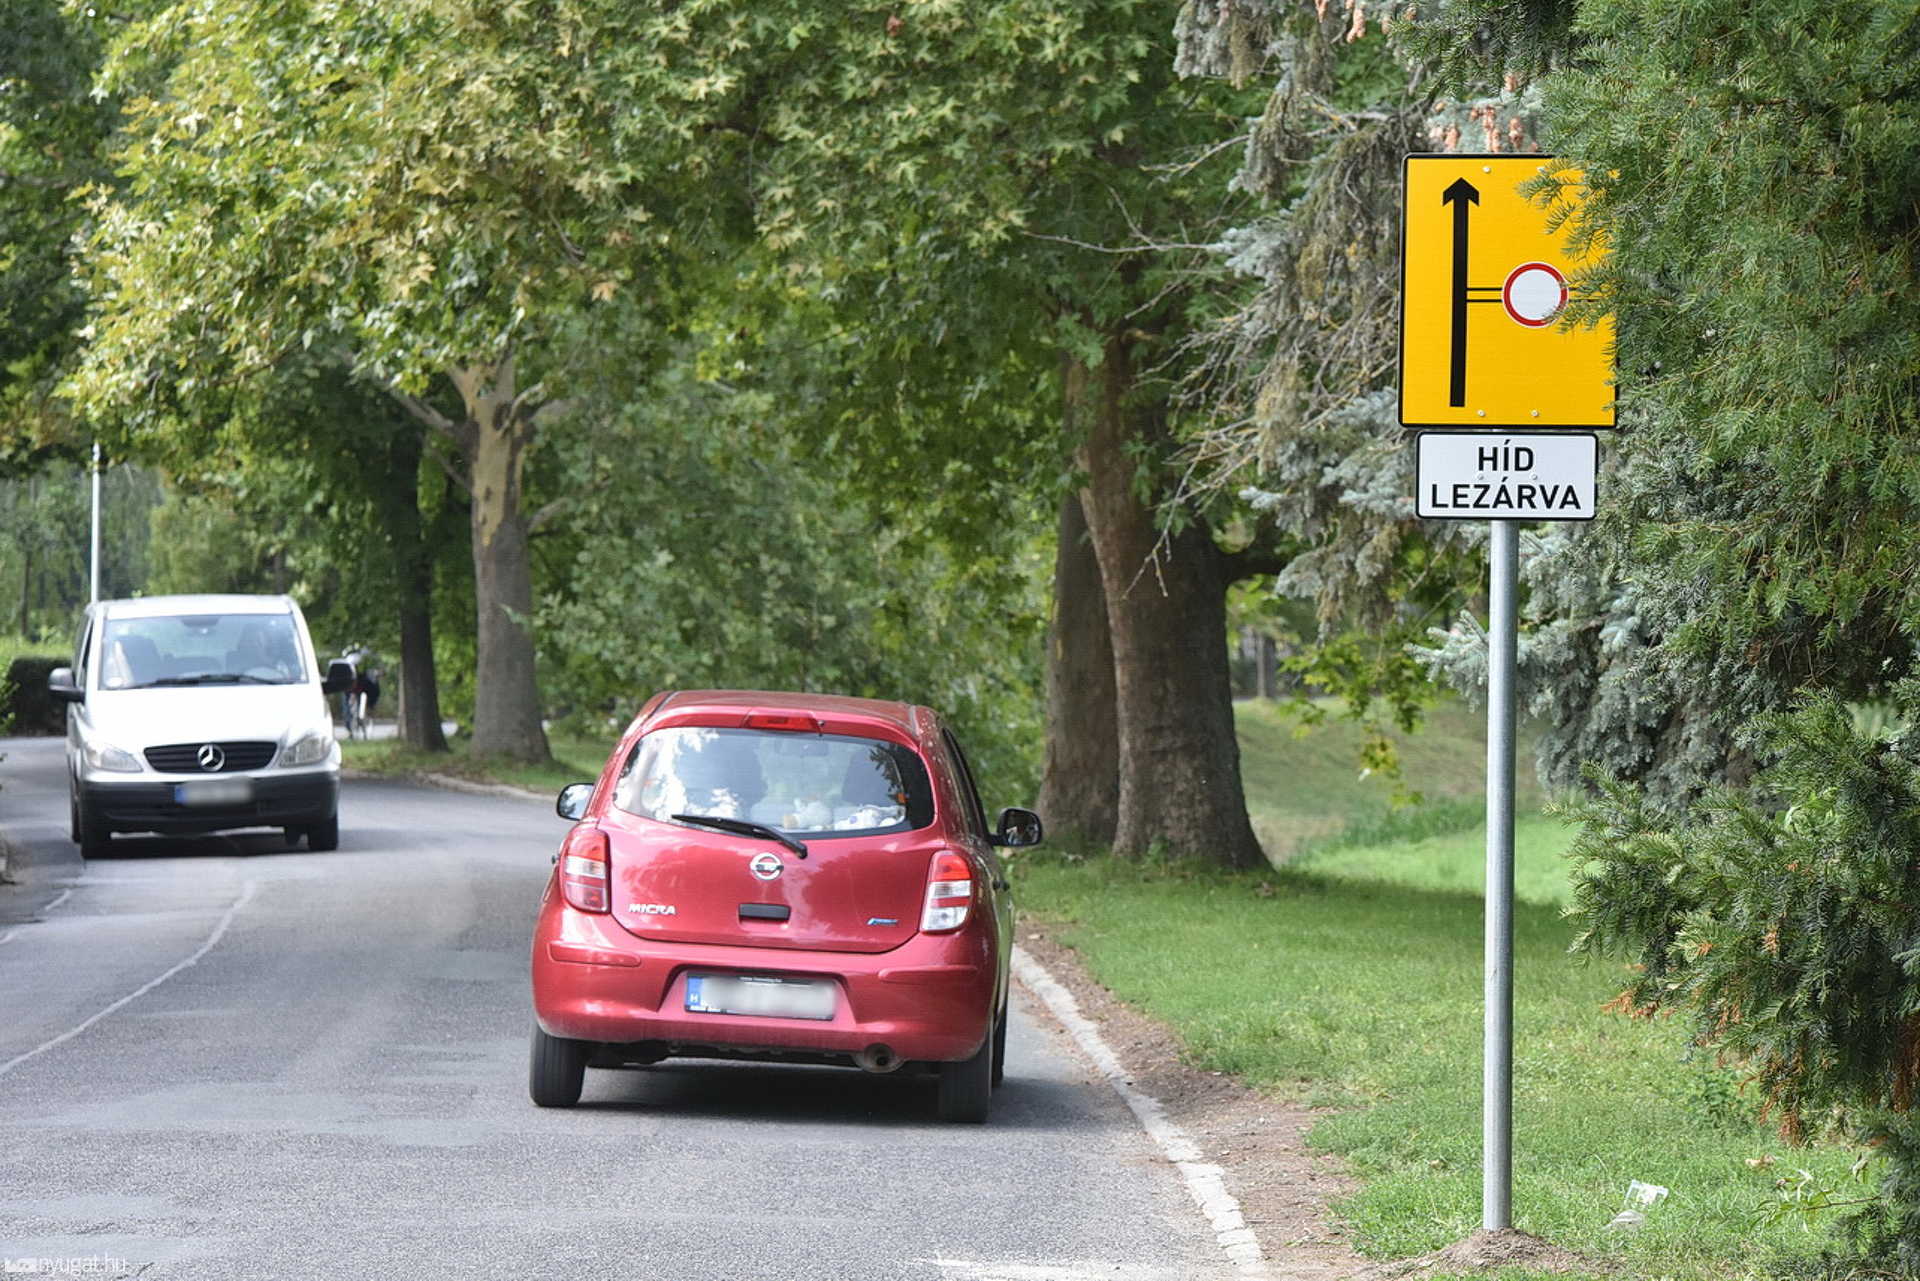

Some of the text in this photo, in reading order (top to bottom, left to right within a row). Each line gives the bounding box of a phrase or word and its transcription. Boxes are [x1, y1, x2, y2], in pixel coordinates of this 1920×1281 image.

[1478, 439, 1535, 472] HÍD
[1431, 476, 1582, 510] LEZÁRVA
[629, 903, 676, 916] MICRA
